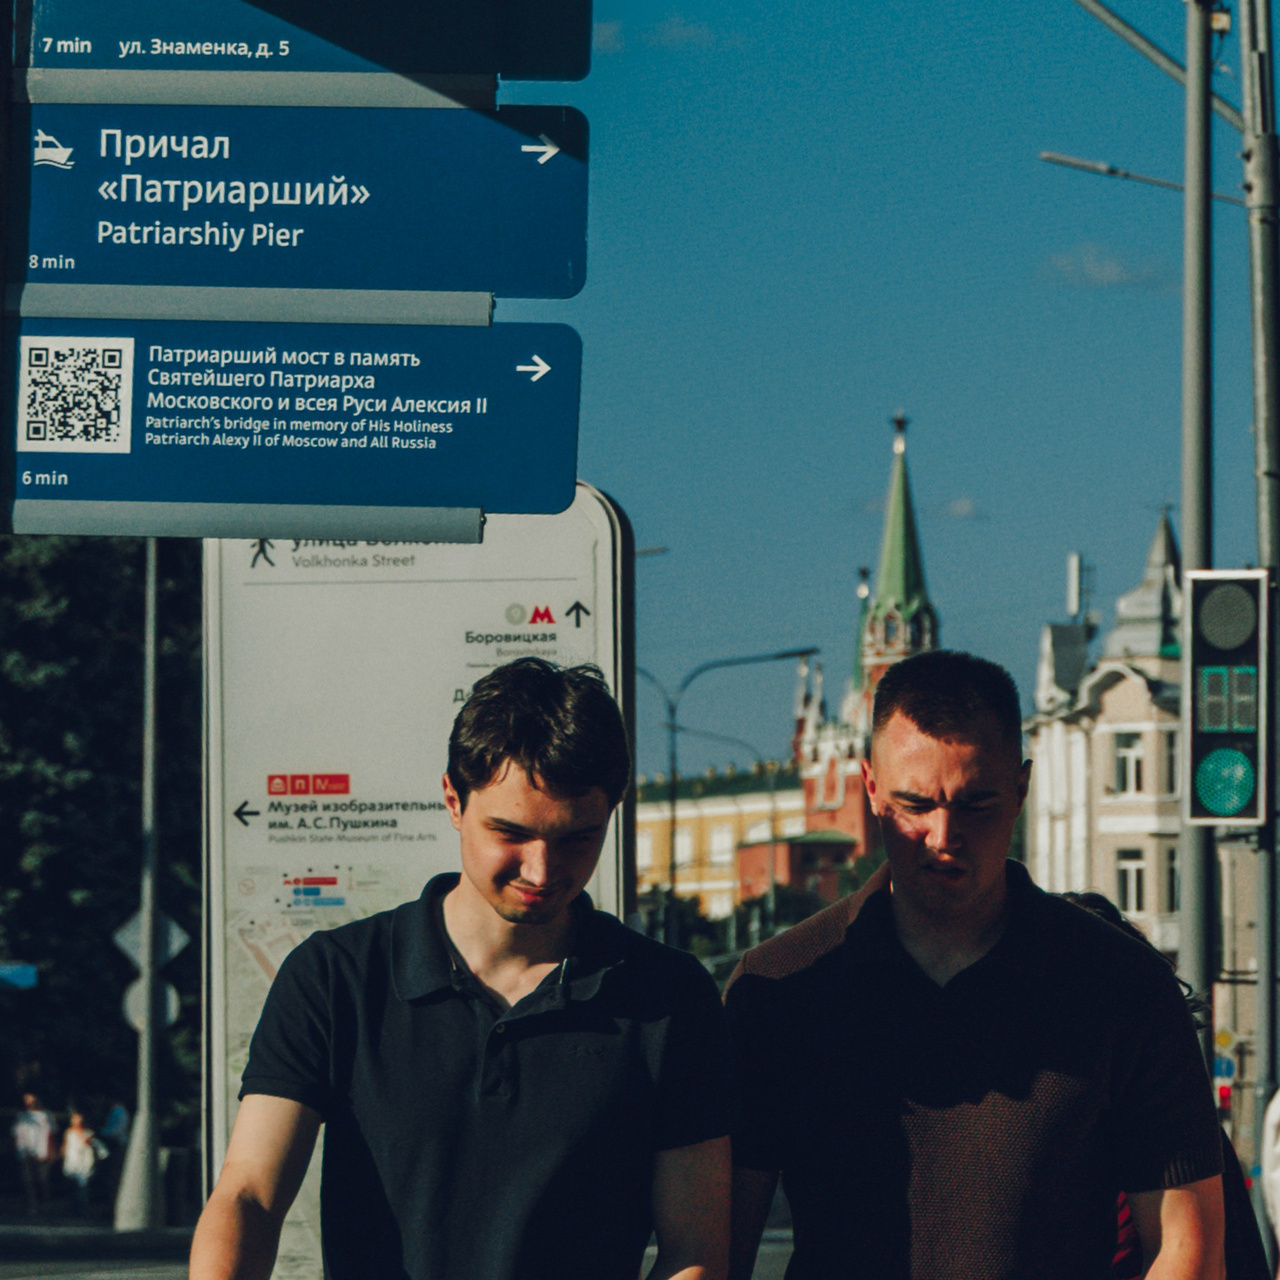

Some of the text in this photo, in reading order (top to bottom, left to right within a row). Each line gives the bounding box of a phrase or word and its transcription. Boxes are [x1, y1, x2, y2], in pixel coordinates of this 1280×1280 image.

[42, 36, 92, 54] 7 min
[118, 38, 290, 59] ул. Знаменка, д. 5
[100, 128, 230, 166] Причал
[98, 173, 371, 212] «Патриарший»
[97, 220, 304, 253] Patriarshiy Pier
[29, 254, 75, 269] 8 min
[149, 345, 421, 368] Патриарший мост в память
[147, 368, 375, 393] Святейшего Патриарха
[147, 392, 487, 417] Московского и всея Руси Алексия II
[145, 415, 453, 435] Patriarch's bridge in memory of His Holiness
[145, 432, 437, 449] Patriarch Alexy II of Moscow and All Russia
[22, 470, 68, 485] 6 min
[292, 554, 416, 568] Volkhonka Street
[465, 631, 557, 645] Боровицкая
[268, 800, 318, 816] Музей
